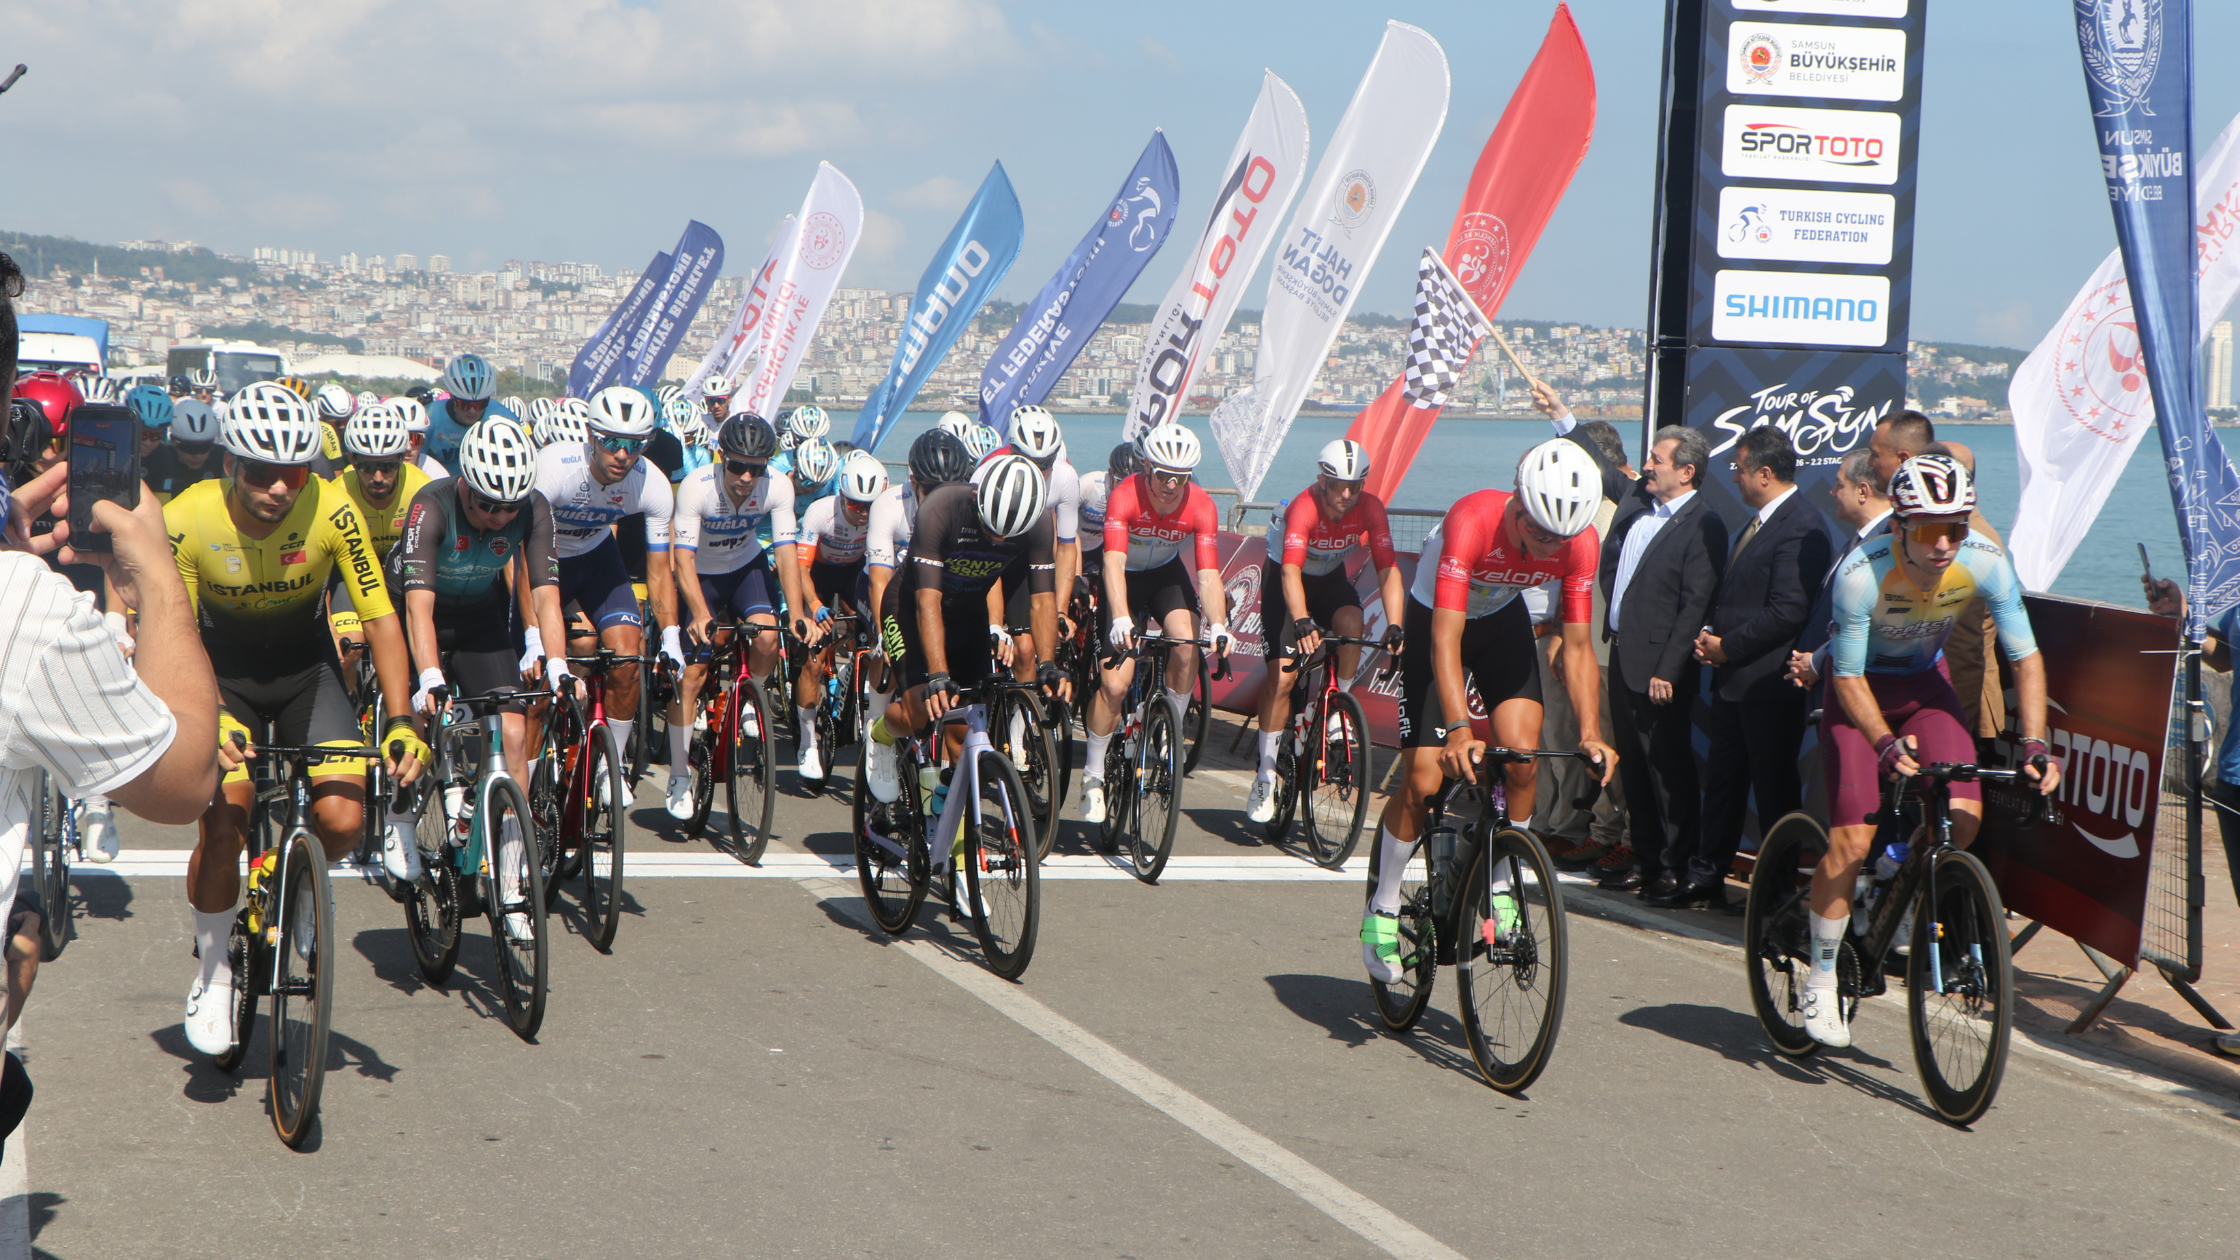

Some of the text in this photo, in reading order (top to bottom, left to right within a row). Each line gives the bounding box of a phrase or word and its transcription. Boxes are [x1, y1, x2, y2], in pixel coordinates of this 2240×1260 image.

[1791, 40, 1835, 50] SAMSUN
[1790, 52, 1896, 73] BÜYÜKŞEHİR
[1789, 72, 1849, 83] BELEDİYESİ
[1780, 210, 1885, 226] TURKISH CYCLING
[1794, 229, 1868, 243] FEDERATION
[1726, 294, 1878, 322] SHIMANO
[632, 463, 646, 475] UĞLA
[329, 503, 381, 597] İSTANBUL
[1961, 540, 2002, 557] AKROO
[207, 573, 315, 597] İSTANBUL
[884, 615, 907, 662] KONYA
